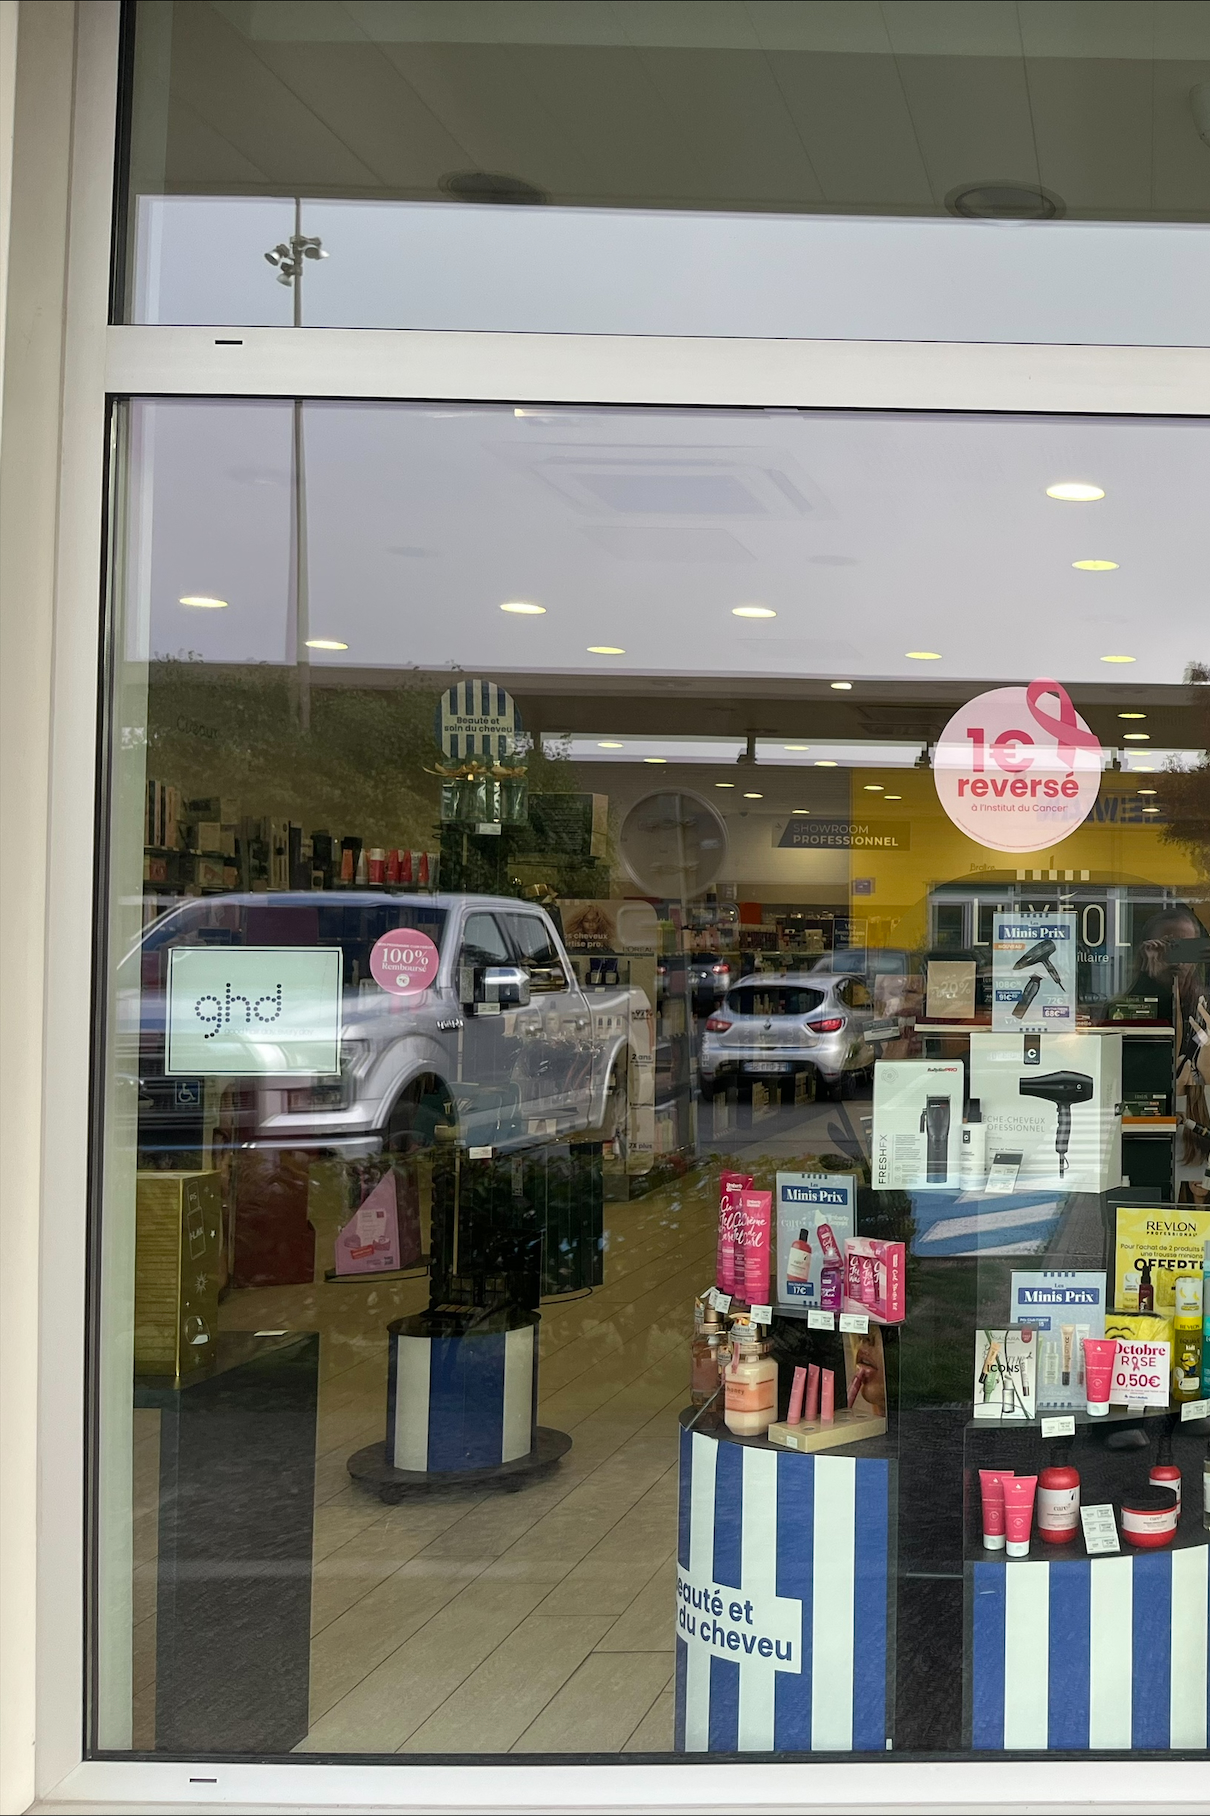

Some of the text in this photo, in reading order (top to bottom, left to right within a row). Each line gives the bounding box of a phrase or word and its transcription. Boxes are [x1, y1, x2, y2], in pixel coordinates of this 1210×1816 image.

[456, 716, 500, 725] Beauté et
[444, 723, 513, 733] soin du cheveu
[967, 728, 1034, 773] 1€
[957, 771, 1079, 798] reversé
[971, 803, 1067, 812] à l'Institut du Cancer
[793, 823, 869, 834] SHOWROOM
[793, 835, 899, 846] PROFESSIONNEL
[1004, 928, 1066, 939] Minis Prix
[383, 948, 429, 966] 100%
[1077, 951, 1109, 962] illaire
[382, 962, 427, 972] Remboursé
[195, 983, 282, 1039] ghd
[983, 1113, 1046, 1124] ÈCHE-CHEVEUX
[987, 1123, 1046, 1133] OFESSIONNEL
[878, 1134, 888, 1184] FRESHFX
[786, 1189, 844, 1203] Minis Prix
[1146, 1221, 1197, 1232] REVLON
[1136, 1243, 1158, 1251] l'achat
[1024, 1290, 1094, 1302] Minis Prix
[1115, 1342, 1166, 1356] Octobre
[986, 1364, 1020, 1373] ICONS
[1116, 1373, 1161, 1388] 0,50€
[677, 1577, 754, 1625] eauté et
[679, 1605, 792, 1661] du cheveu
